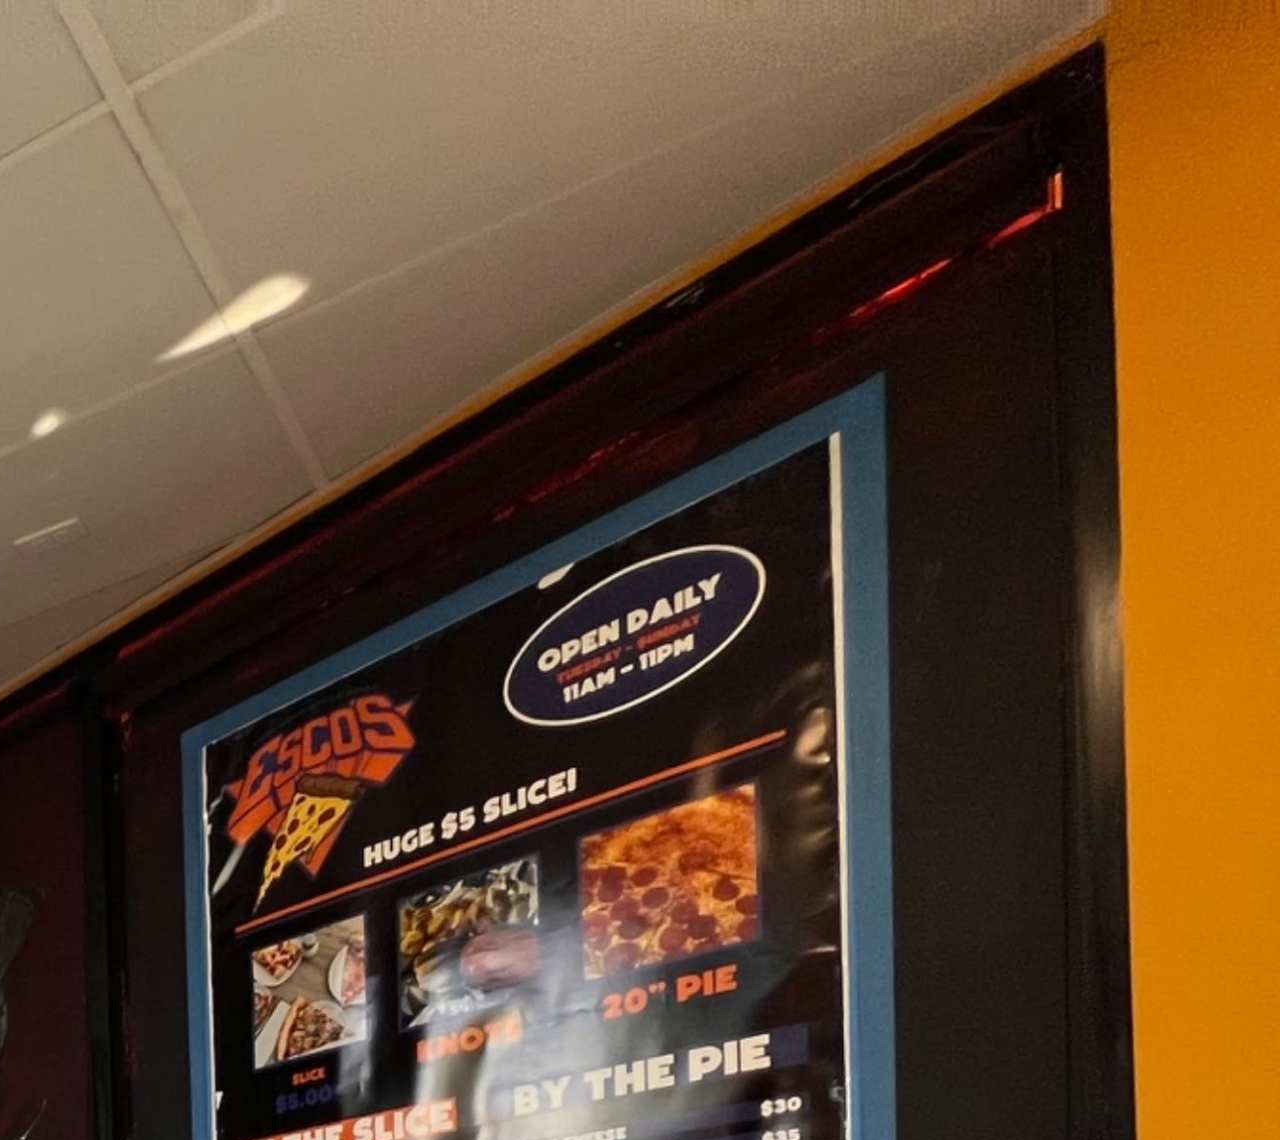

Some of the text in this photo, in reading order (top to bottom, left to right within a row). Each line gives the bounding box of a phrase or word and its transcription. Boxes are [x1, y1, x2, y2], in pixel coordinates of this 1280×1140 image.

[538, 573, 721, 672] OPEN DAILY
[563, 668, 615, 703] 11AM
[638, 634, 694, 670] 11PM
[237, 694, 416, 812] ESCOS
[363, 767, 577, 868] HUGE $5 SLICE!
[676, 965, 738, 1003] PIE
[292, 1067, 326, 1086] SLICE
[514, 1033, 770, 1117] BY THE PIE
[761, 1096, 802, 1117] $30
